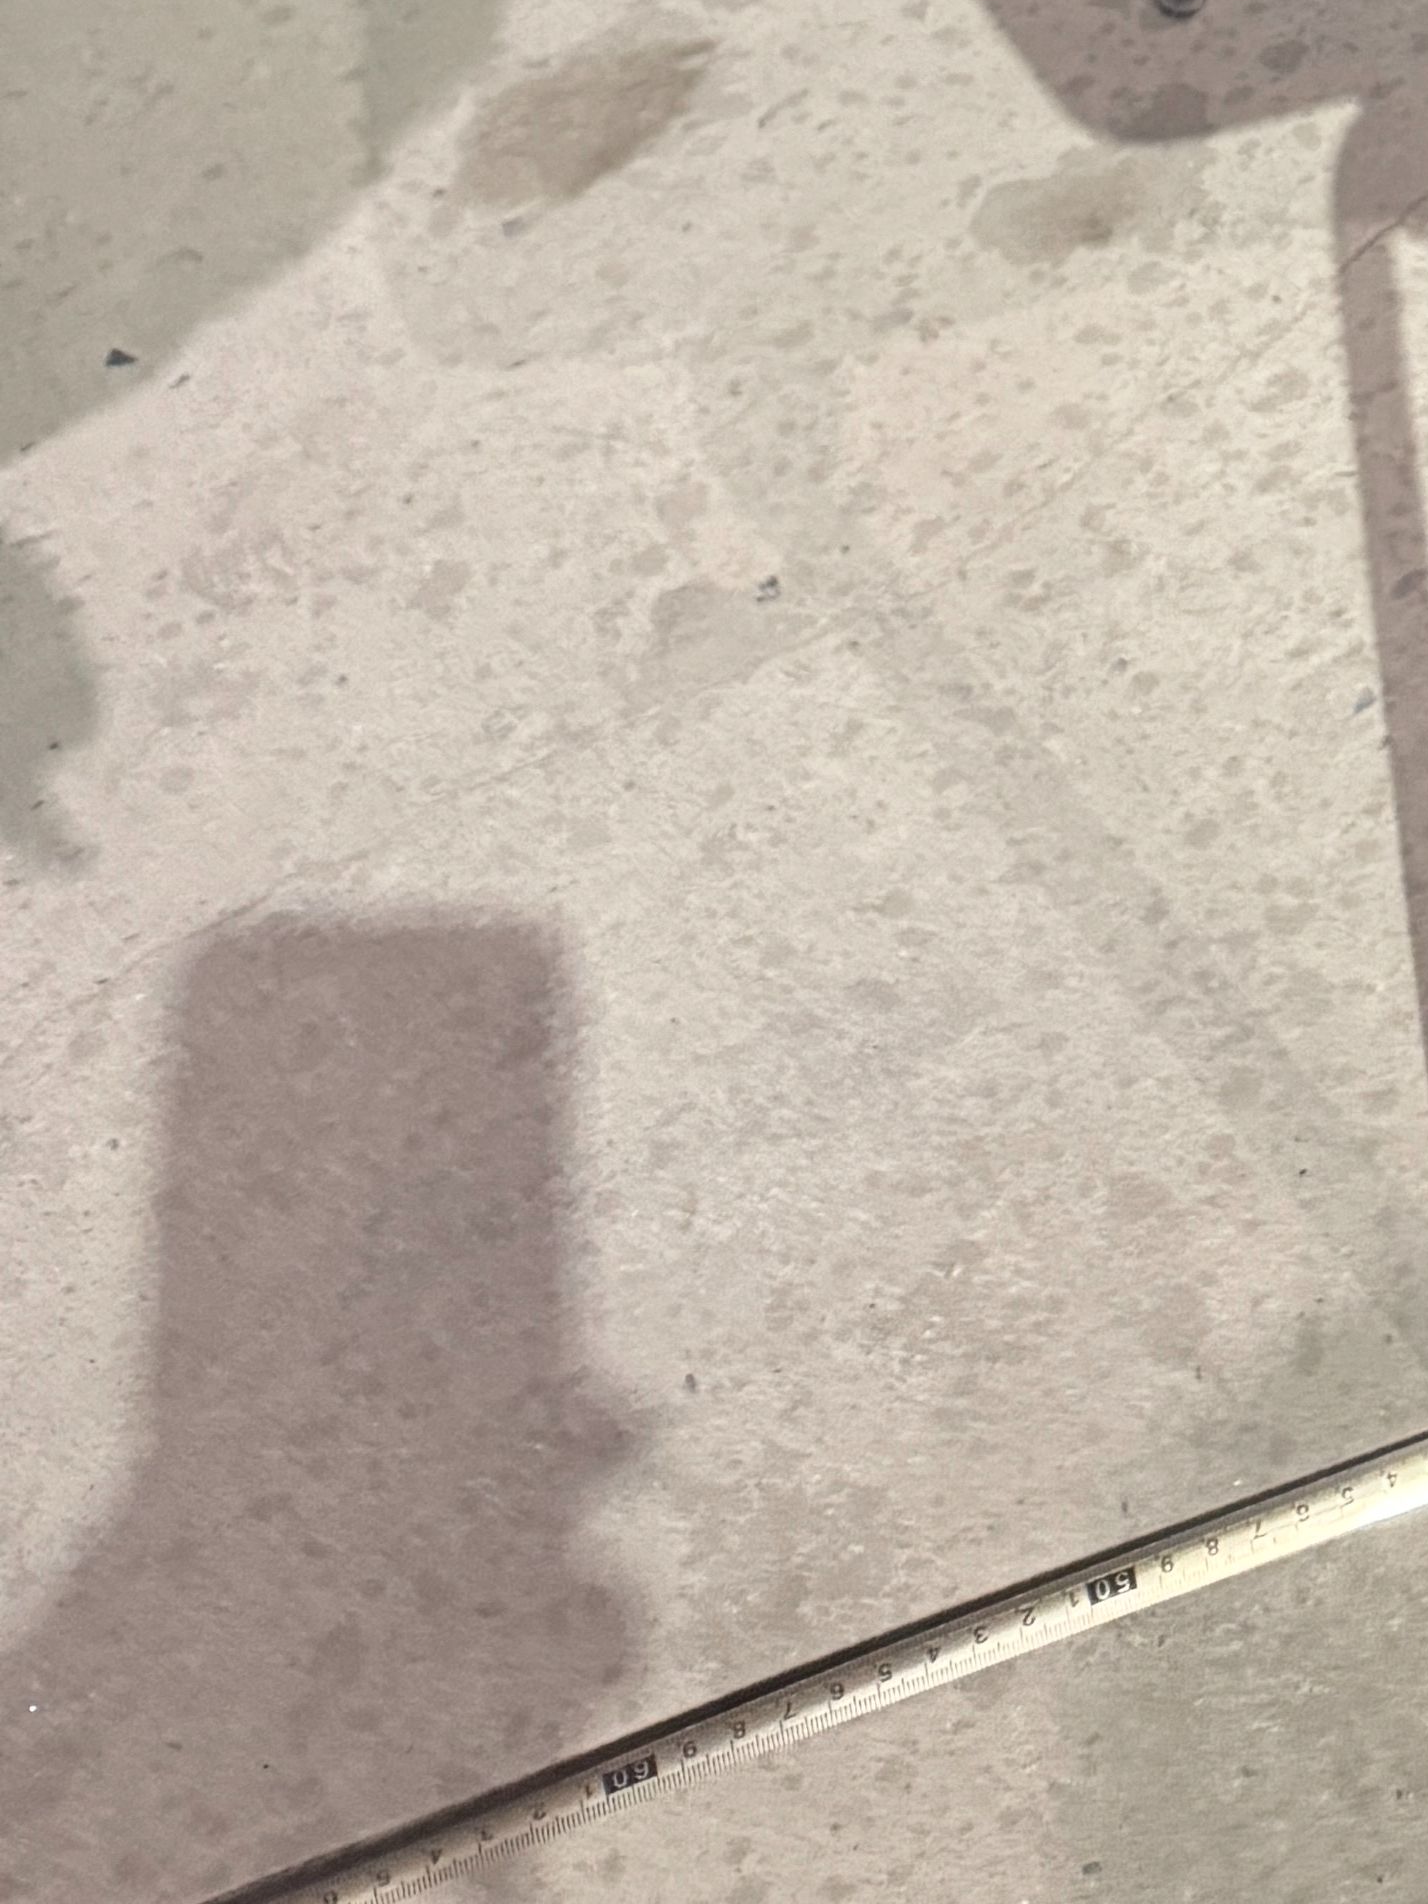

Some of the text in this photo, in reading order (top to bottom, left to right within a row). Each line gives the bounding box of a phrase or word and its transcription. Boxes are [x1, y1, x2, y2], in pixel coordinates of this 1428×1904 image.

[1385, 1471, 1398, 1488] 4
[1341, 1486, 1355, 1506] 5
[1296, 1503, 1310, 1523] 6
[1206, 1537, 1219, 1556] 8
[1160, 1554, 1175, 1574] 9
[1094, 1568, 1133, 1602] 50
[1015, 1606, 1037, 1627] 2
[973, 1624, 990, 1644] 3
[926, 1646, 942, 1664] 4
[876, 1662, 894, 1683] 5
[829, 1682, 845, 1701] 6
[732, 1719, 746, 1739] 8
[682, 1740, 698, 1759] 9
[610, 1758, 651, 1790] 60
